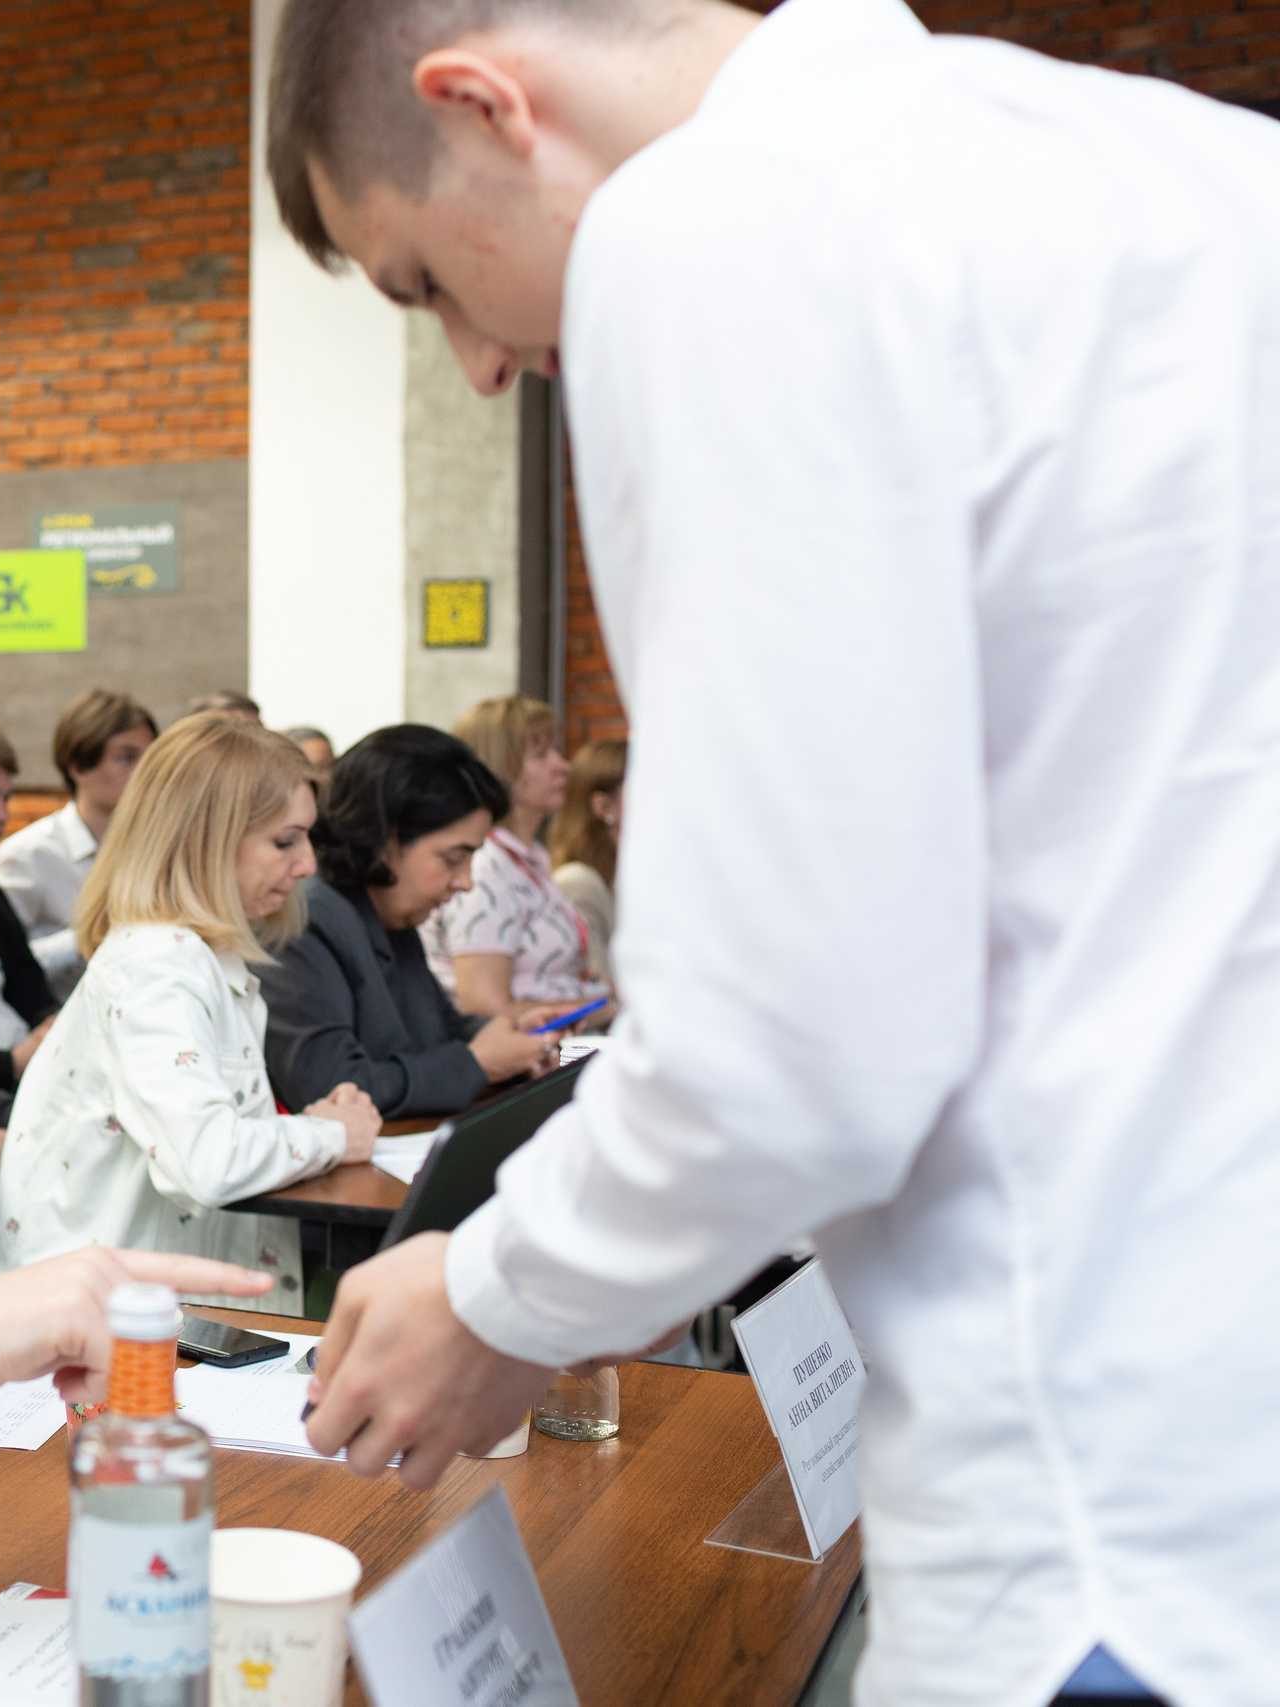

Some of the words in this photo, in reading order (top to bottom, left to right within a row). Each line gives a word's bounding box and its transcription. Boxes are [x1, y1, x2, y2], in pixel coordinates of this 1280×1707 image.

[792, 1341, 833, 1386] ПУШЕНКО
[788, 1397, 813, 1430] АННА
[809, 1357, 857, 1411] ВИТАЛИЕВНА
